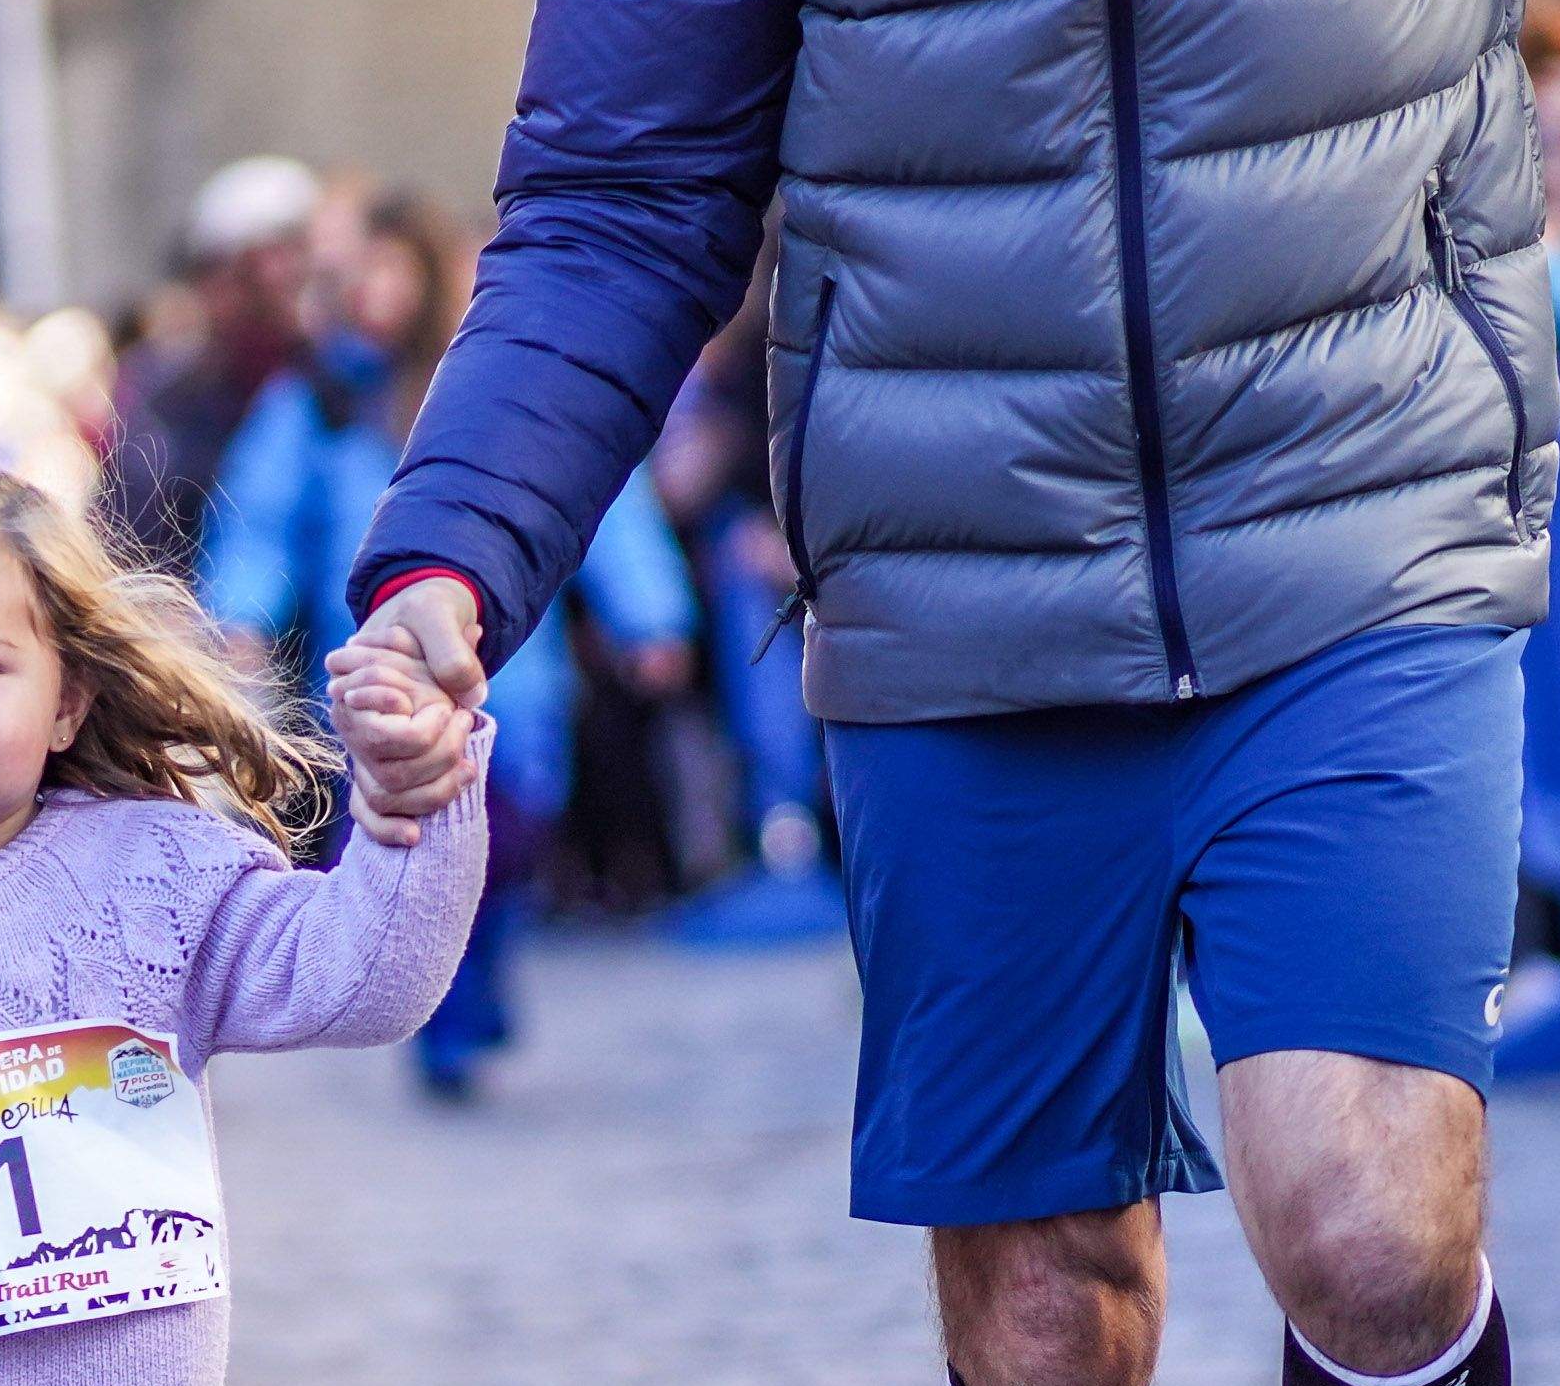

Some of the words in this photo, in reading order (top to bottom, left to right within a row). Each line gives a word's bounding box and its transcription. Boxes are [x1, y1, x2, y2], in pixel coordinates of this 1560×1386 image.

[46, 1045, 63, 1056] DE
[119, 1080, 129, 1093] 7
[131, 1073, 167, 1085] PICOS
[52, 1269, 110, 1291] Run
